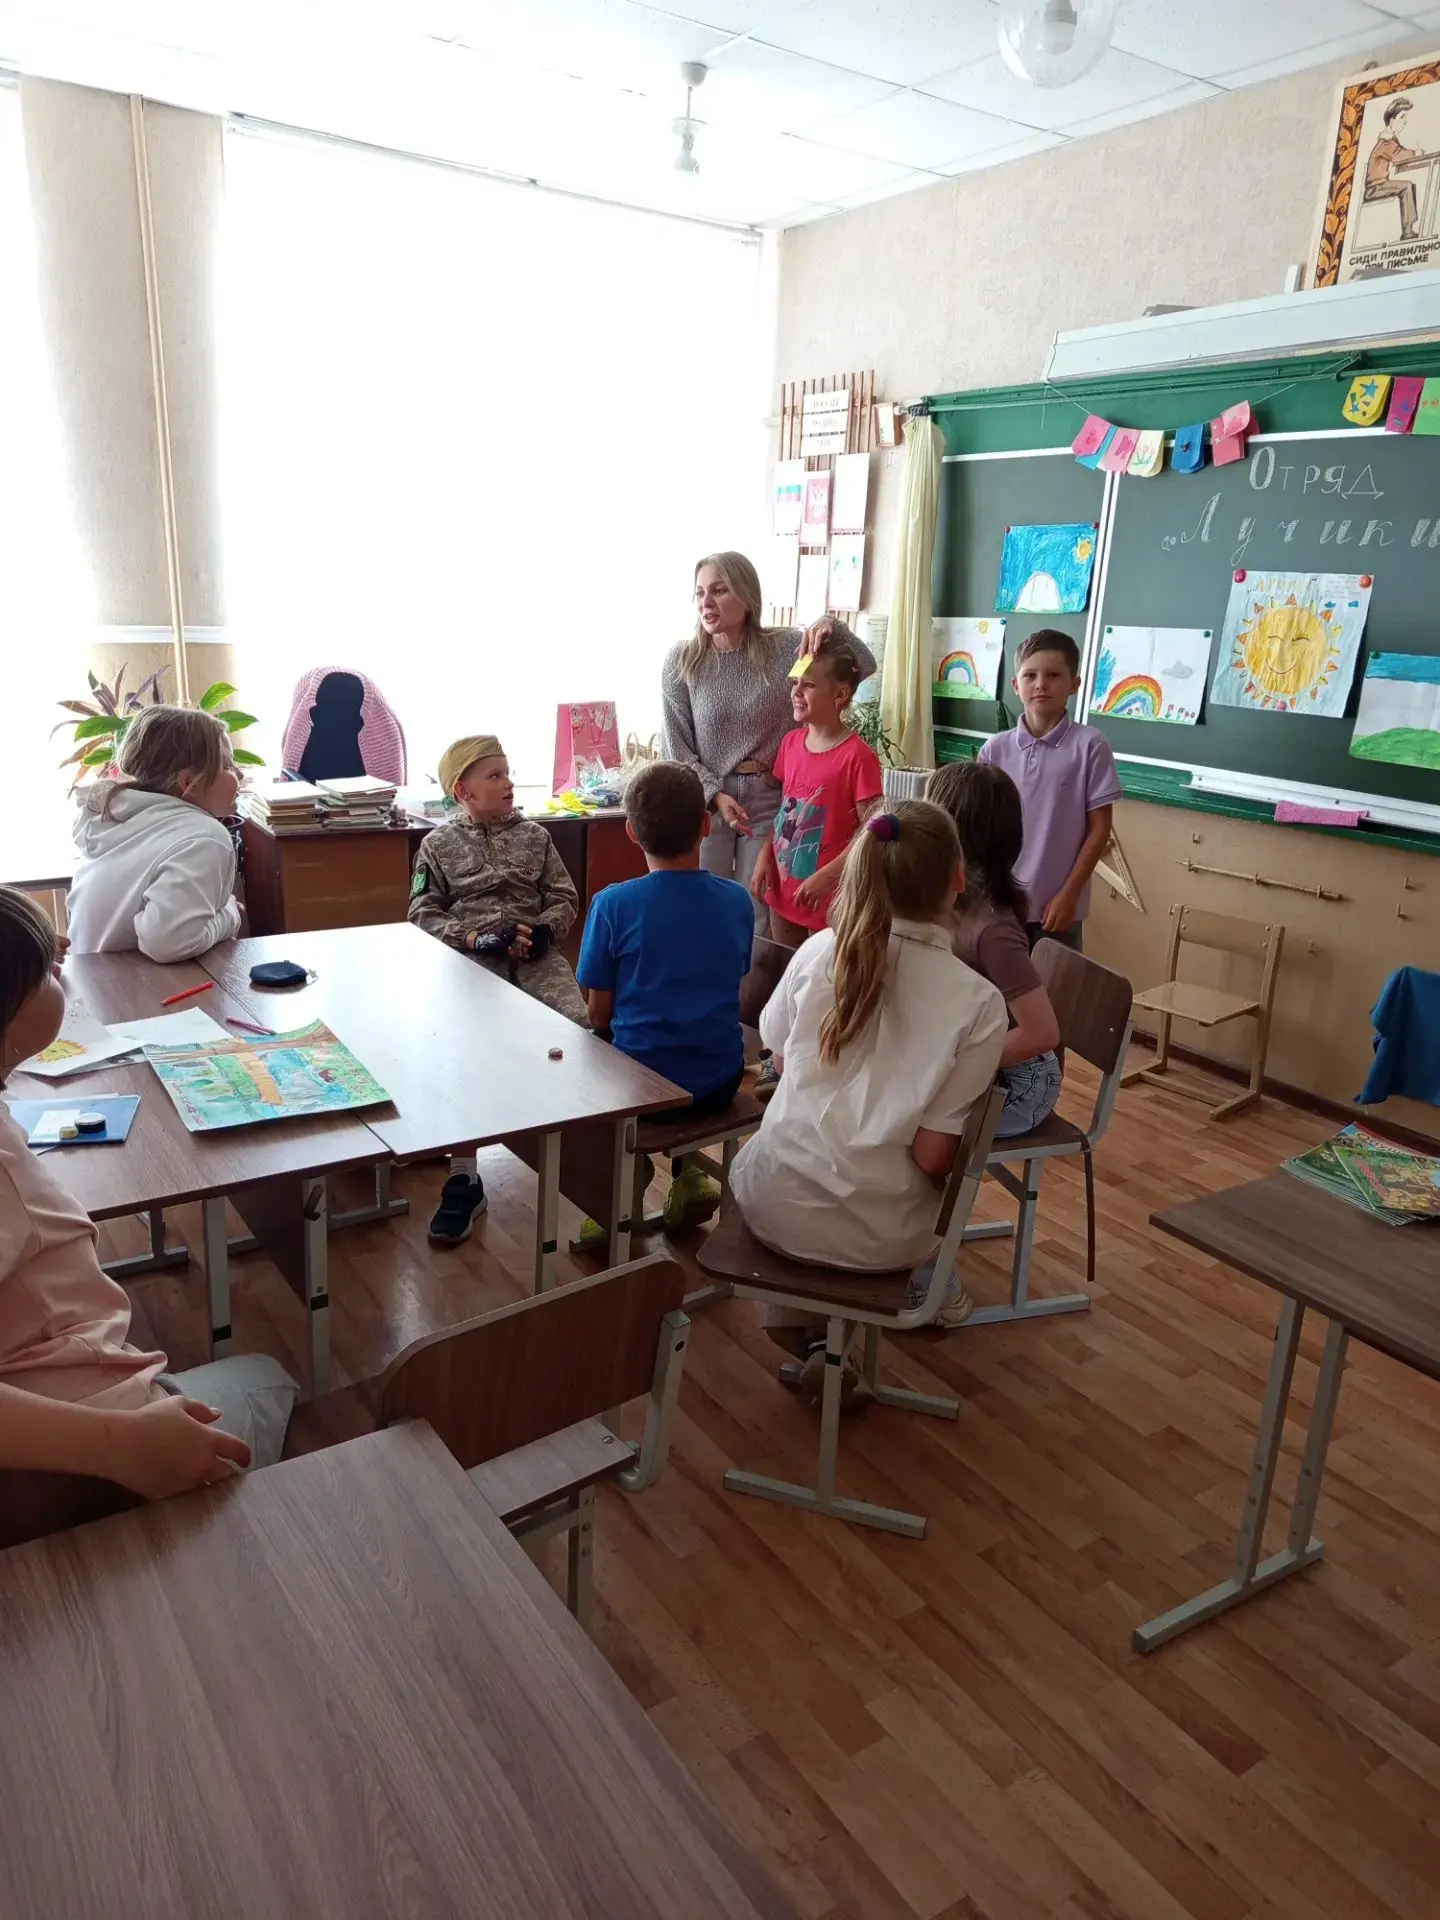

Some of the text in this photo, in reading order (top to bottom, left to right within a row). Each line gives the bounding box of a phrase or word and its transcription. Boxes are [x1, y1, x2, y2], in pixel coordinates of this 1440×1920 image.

[1349, 241, 1440, 266] СИДИ ПРАВИЛЬНО
[1387, 254, 1429, 270] ПИСЬМЕ
